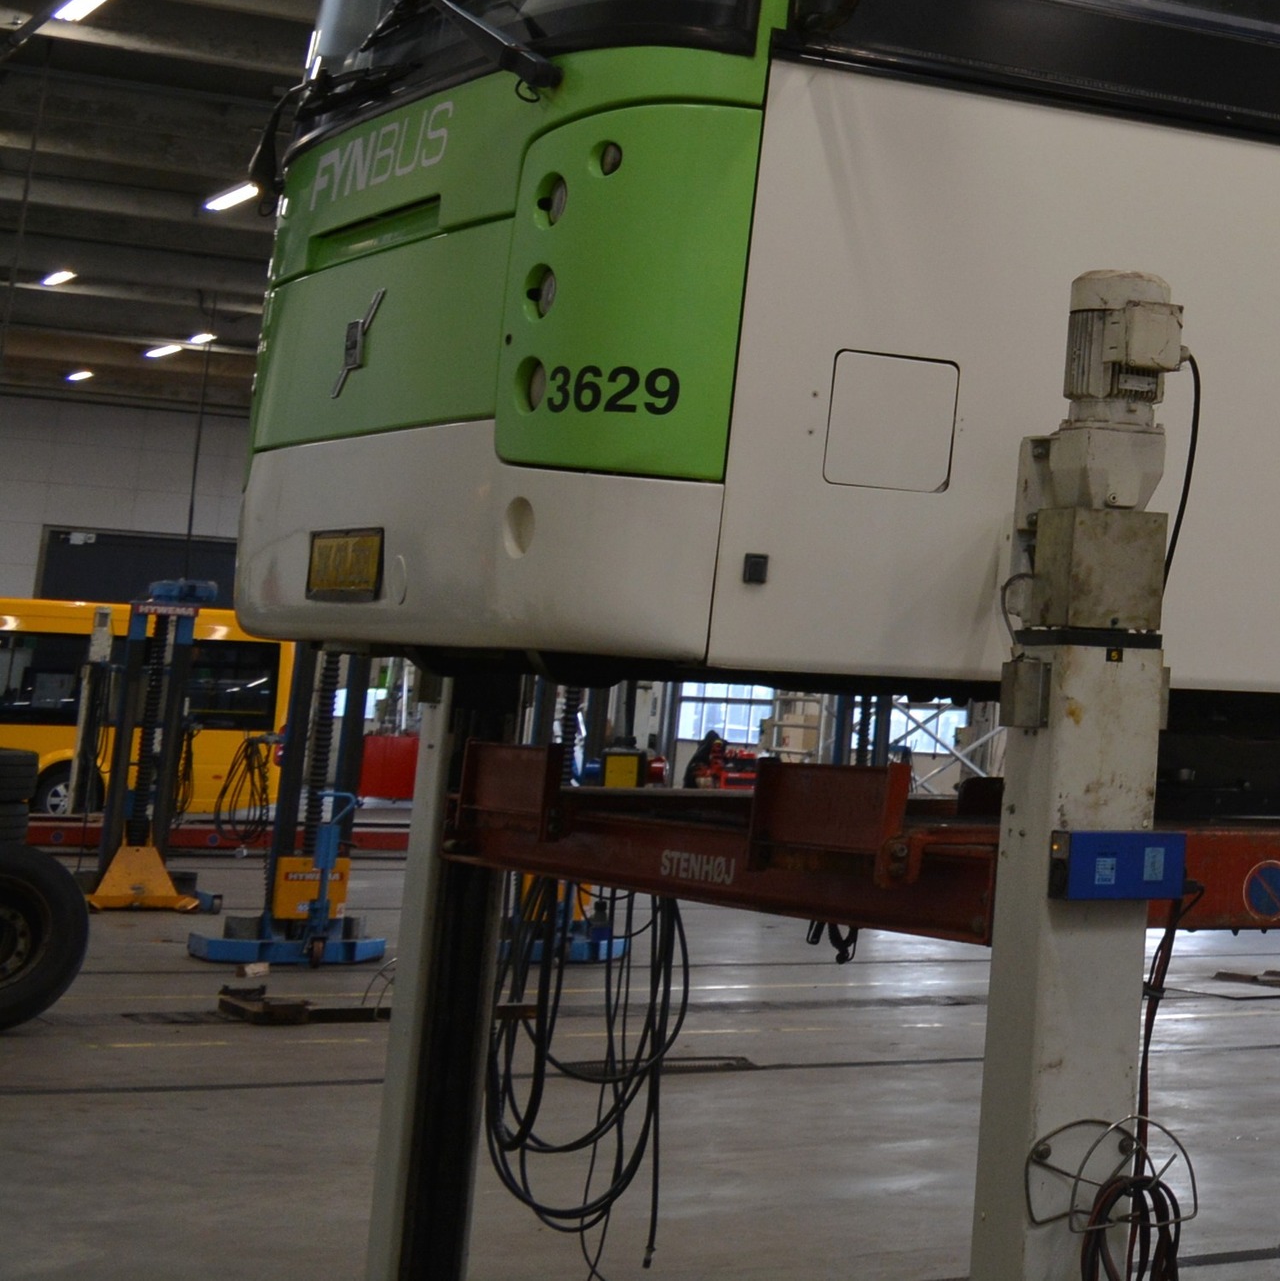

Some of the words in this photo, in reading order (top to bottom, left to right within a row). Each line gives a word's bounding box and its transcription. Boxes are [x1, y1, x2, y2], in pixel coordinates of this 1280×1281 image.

[309, 100, 454, 212] FYNBUS
[546, 365, 681, 416] 3629
[660, 849, 737, 886] STENHØJ
